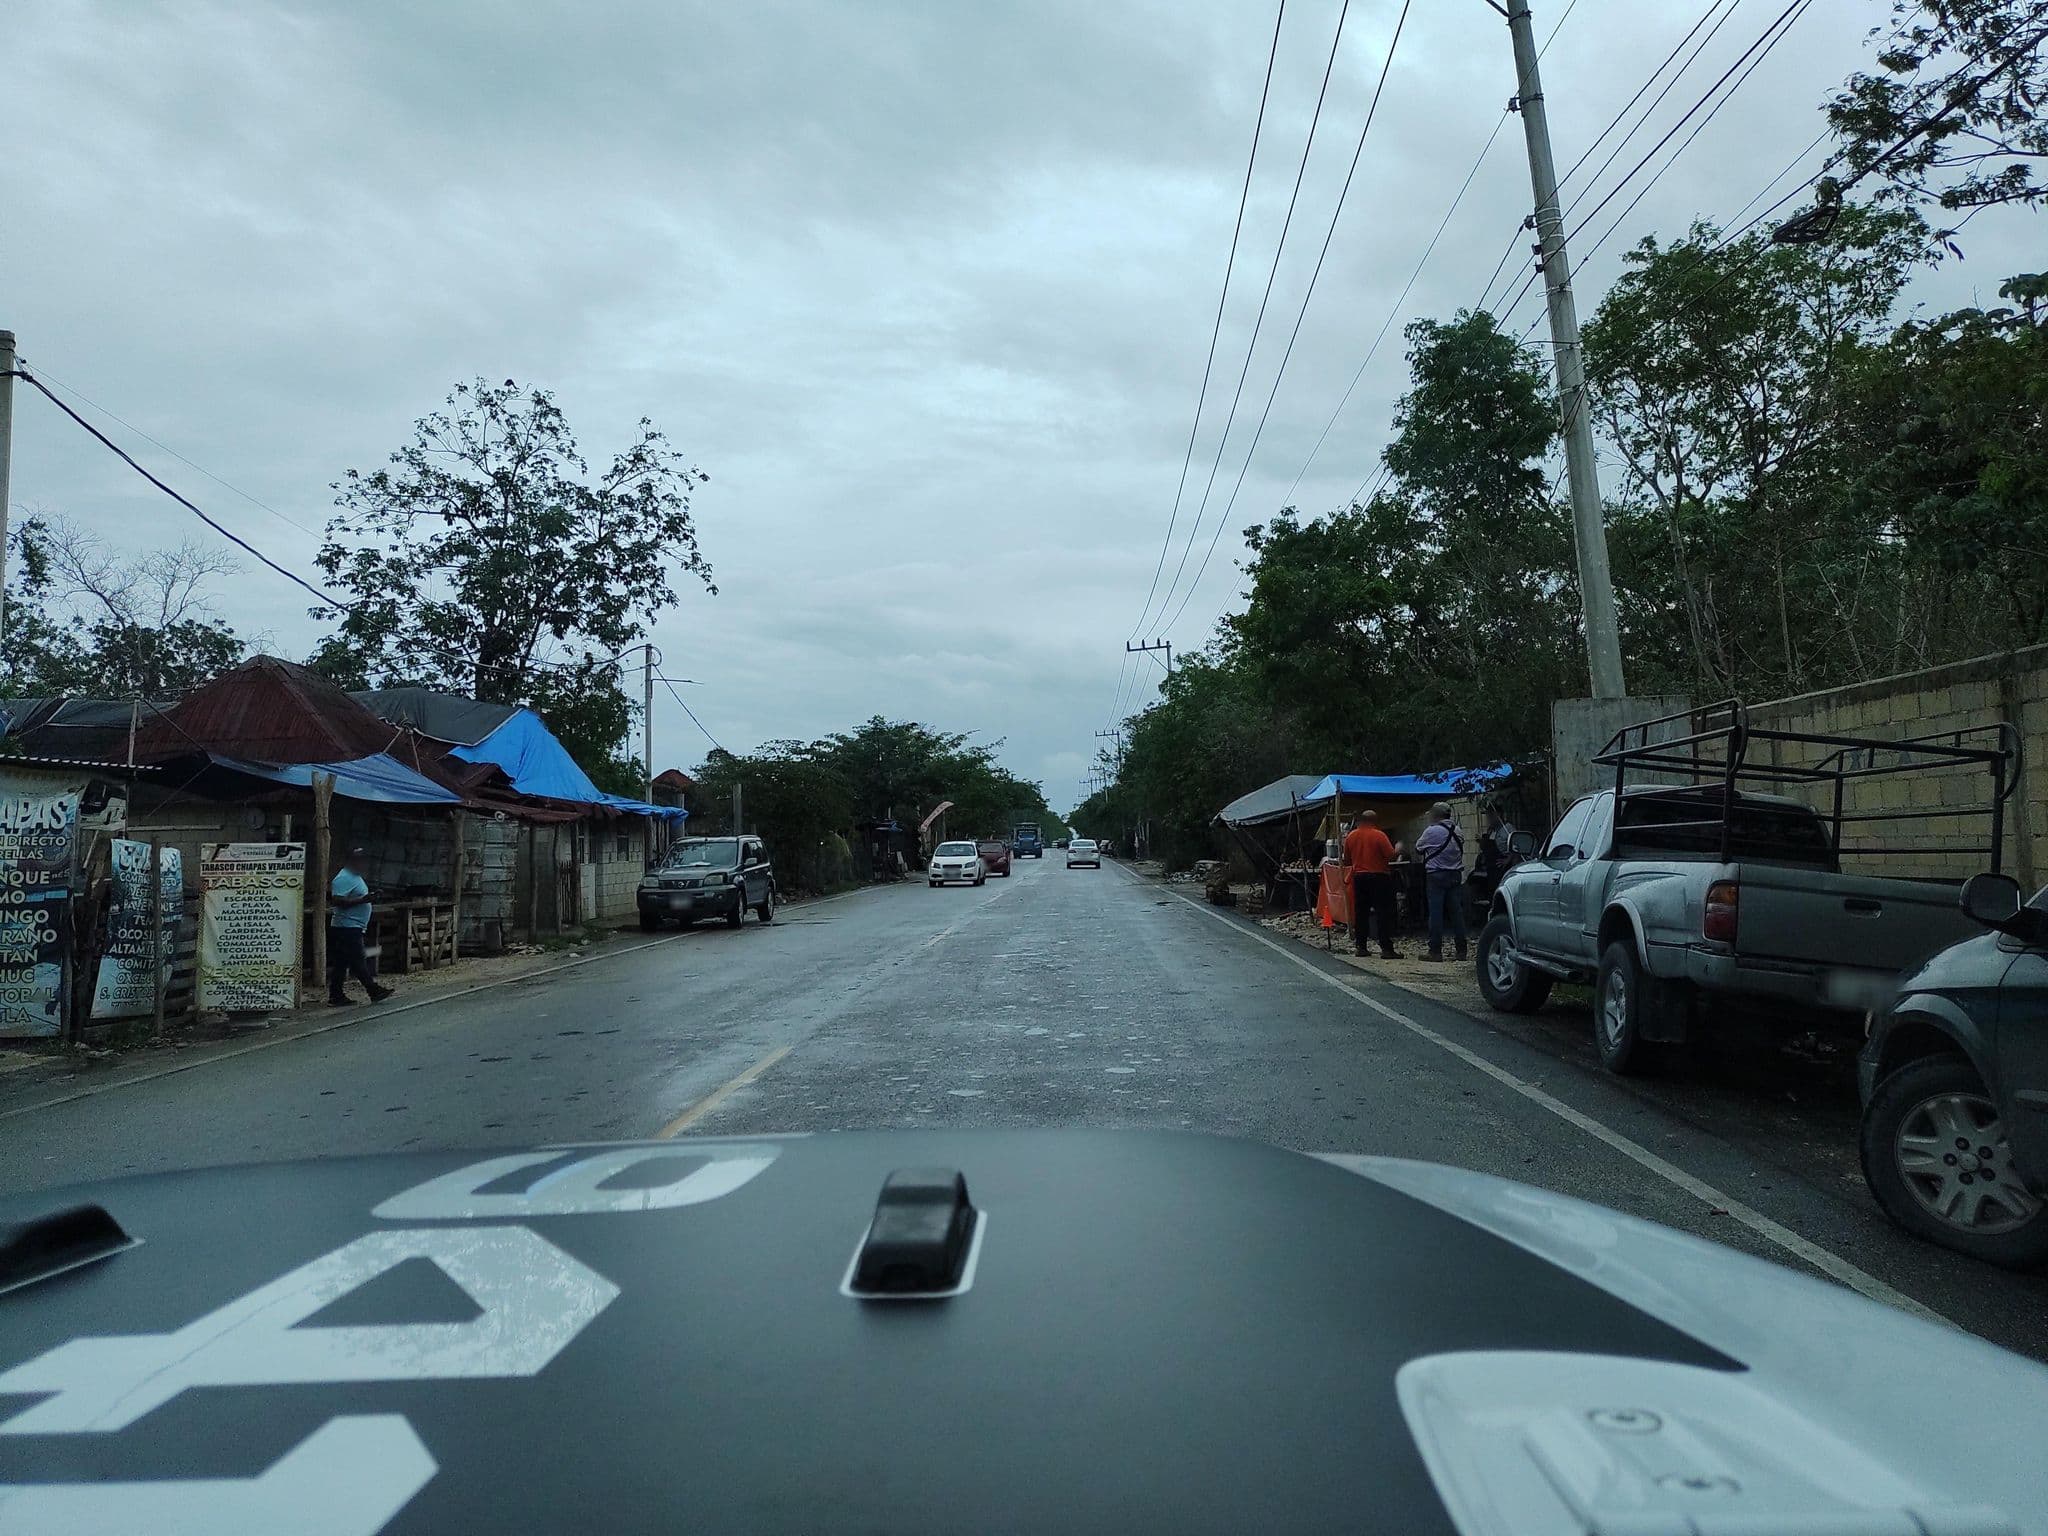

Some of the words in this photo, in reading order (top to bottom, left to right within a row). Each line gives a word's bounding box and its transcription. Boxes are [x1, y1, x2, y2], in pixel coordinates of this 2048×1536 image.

[8, 836, 66, 846] DIRECTO
[201, 863, 234, 871] TABASCO
[236, 863, 267, 871] CHIAPAS
[268, 863, 305, 871] VERACRUZ
[203, 876, 301, 890] TABASCO
[1, 928, 58, 943] RANO
[0, 949, 38, 963] TAN
[201, 965, 296, 978] VERACRUZ
[100, 986, 111, 1000] S.
